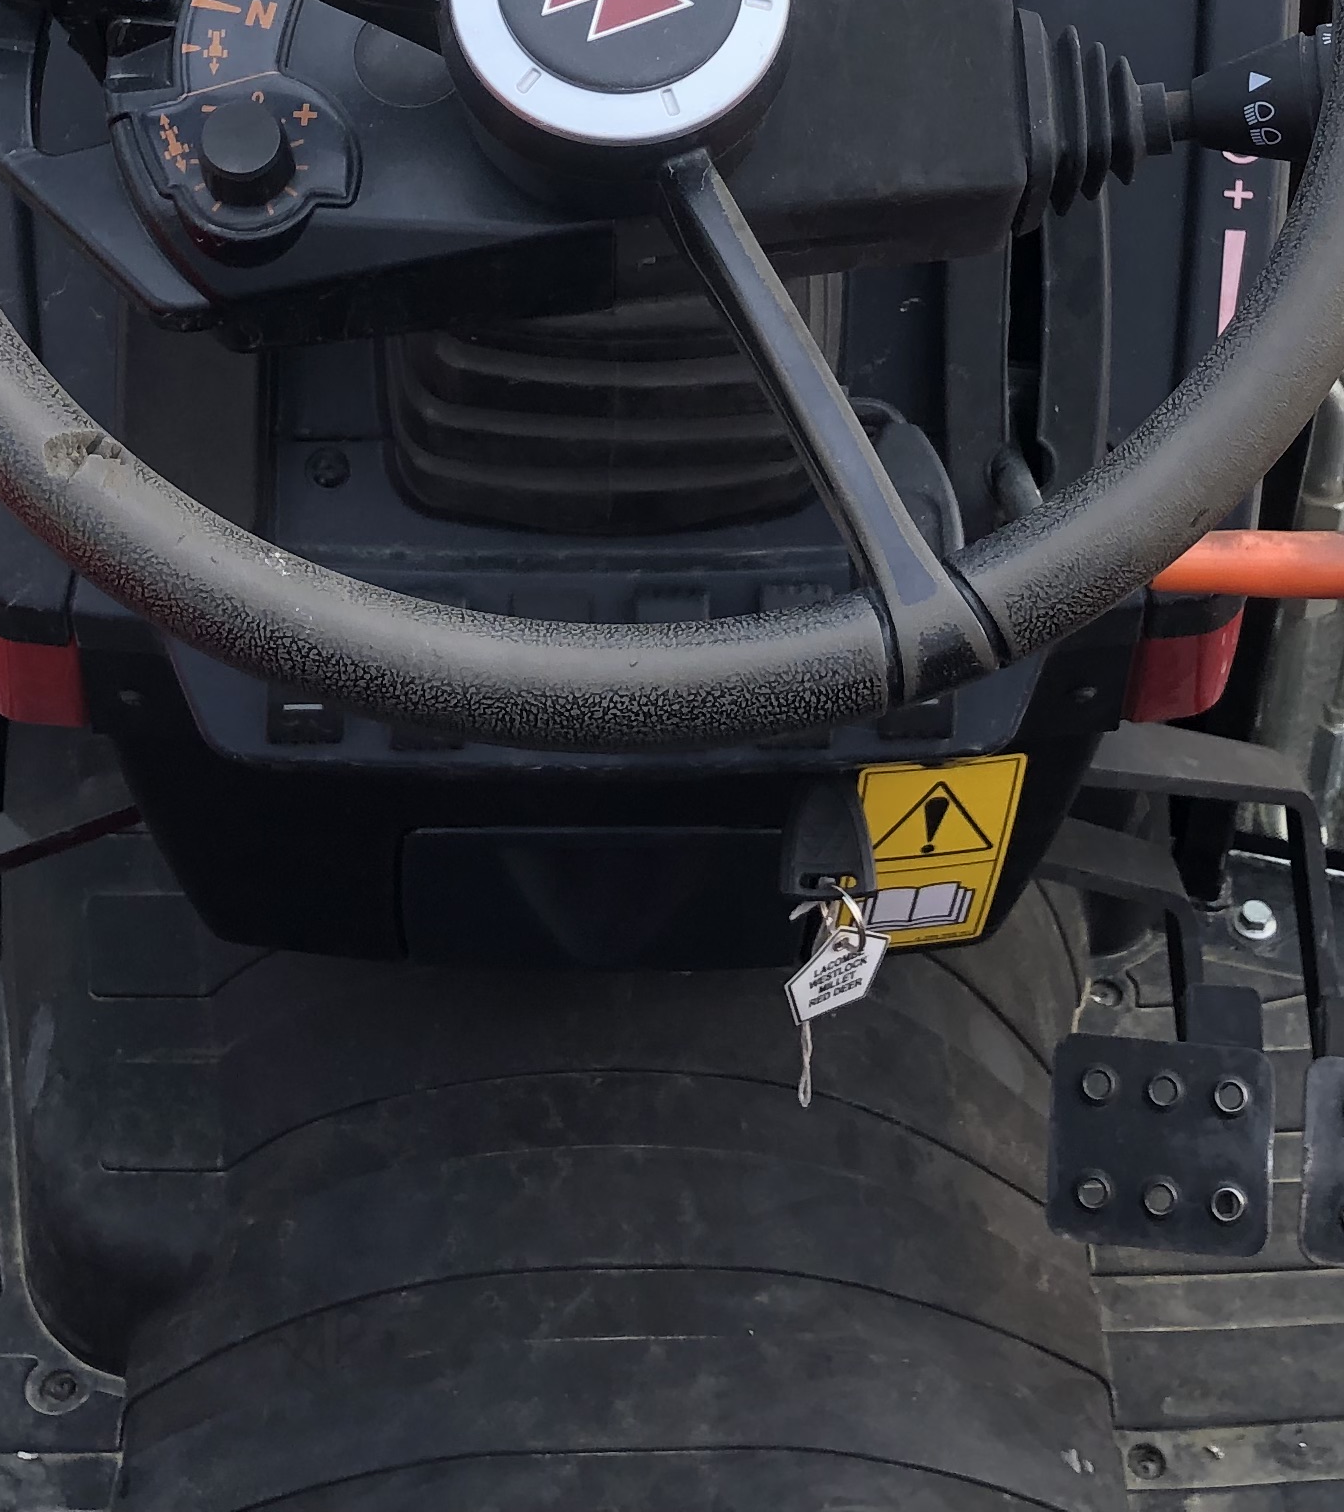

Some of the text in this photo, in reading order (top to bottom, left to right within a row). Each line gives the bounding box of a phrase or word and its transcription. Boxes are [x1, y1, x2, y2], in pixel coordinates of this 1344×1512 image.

[244, 0, 278, 29] N
[809, 955, 869, 989] WESTLOCK
[818, 970, 857, 993] MILLET
[808, 978, 863, 1007] RED DEER
